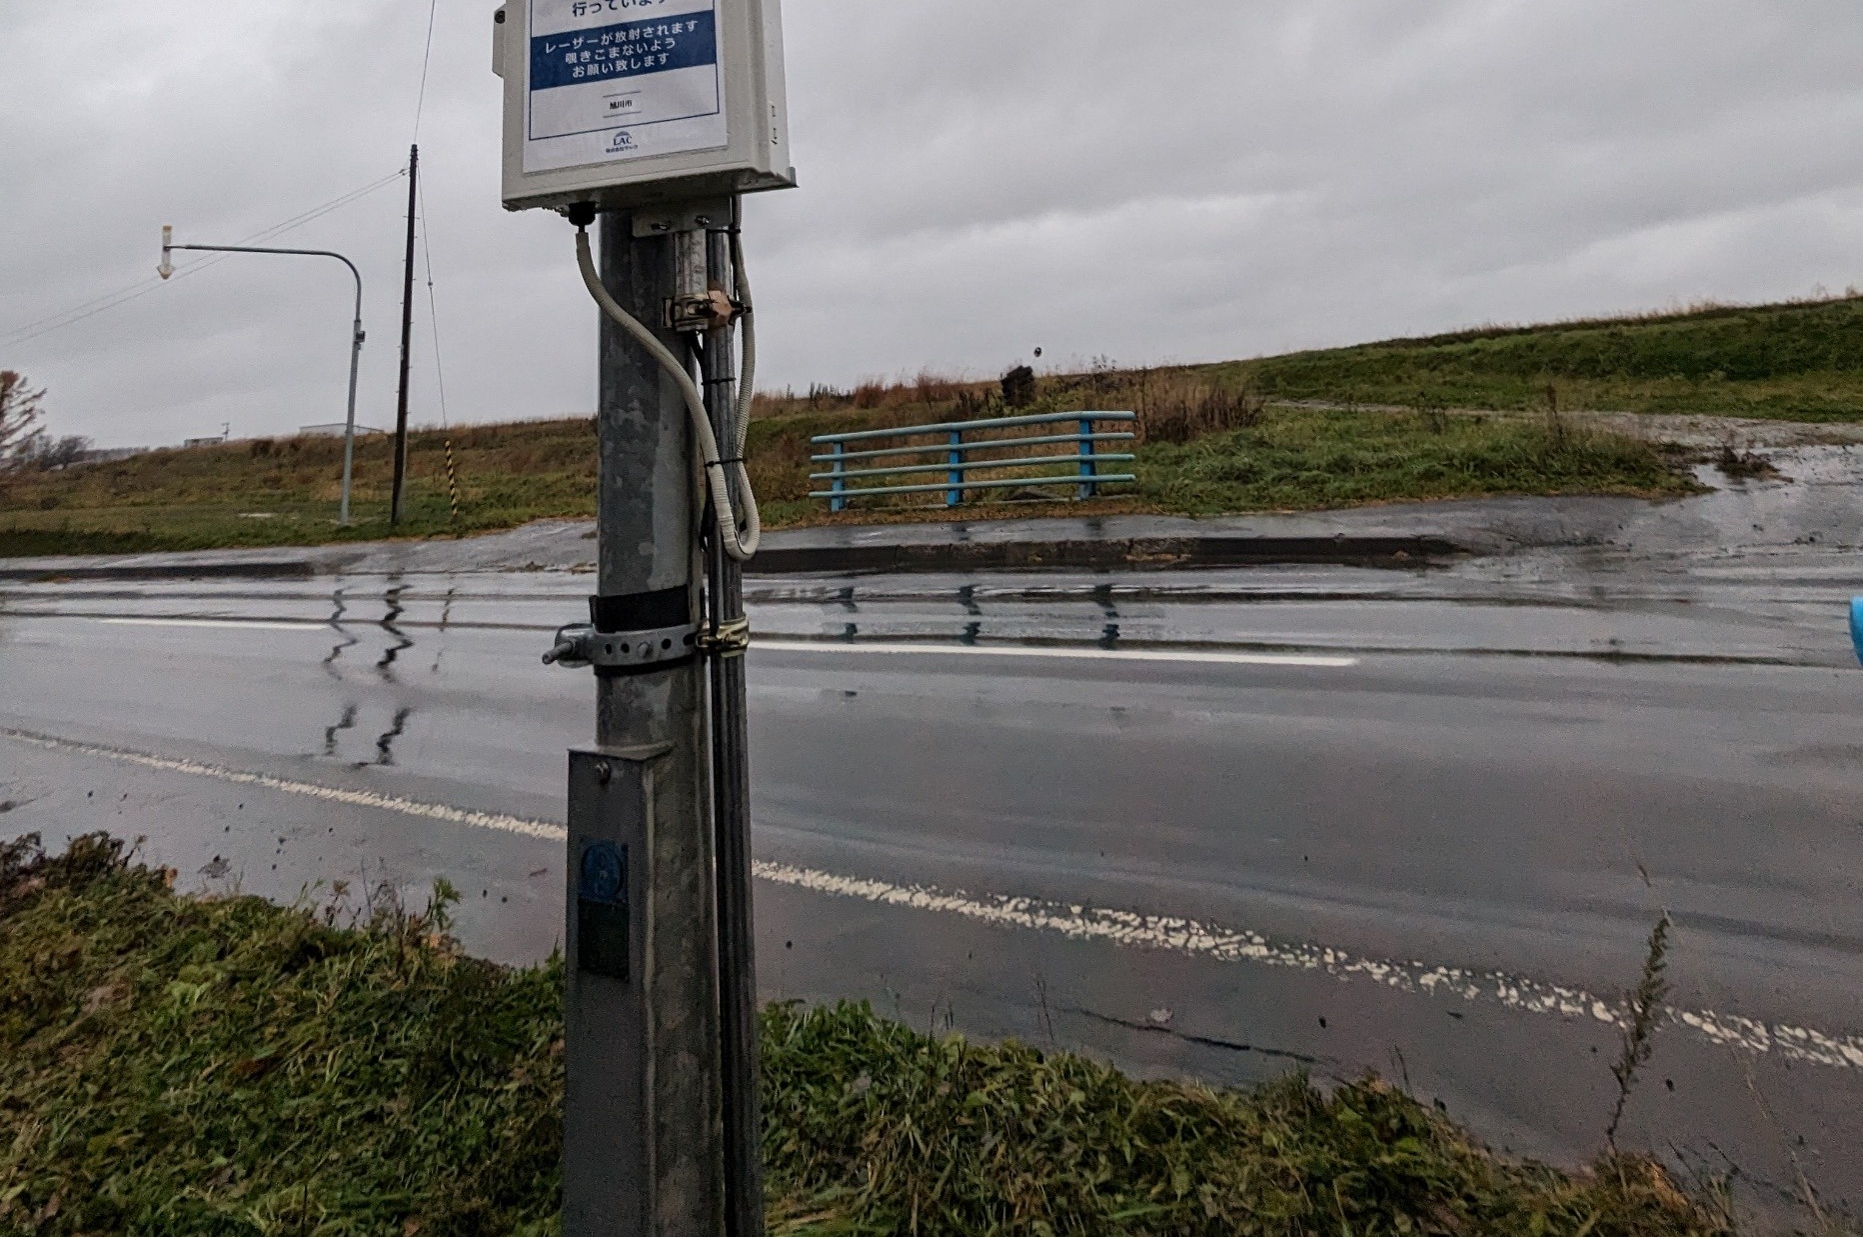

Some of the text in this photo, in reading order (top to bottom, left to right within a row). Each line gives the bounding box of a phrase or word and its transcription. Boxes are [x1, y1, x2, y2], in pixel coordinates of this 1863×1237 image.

[545, 20, 699, 54] レーザーが放射されます
[572, 52, 670, 79] お願い致します
[613, 137, 632, 146] LAC
